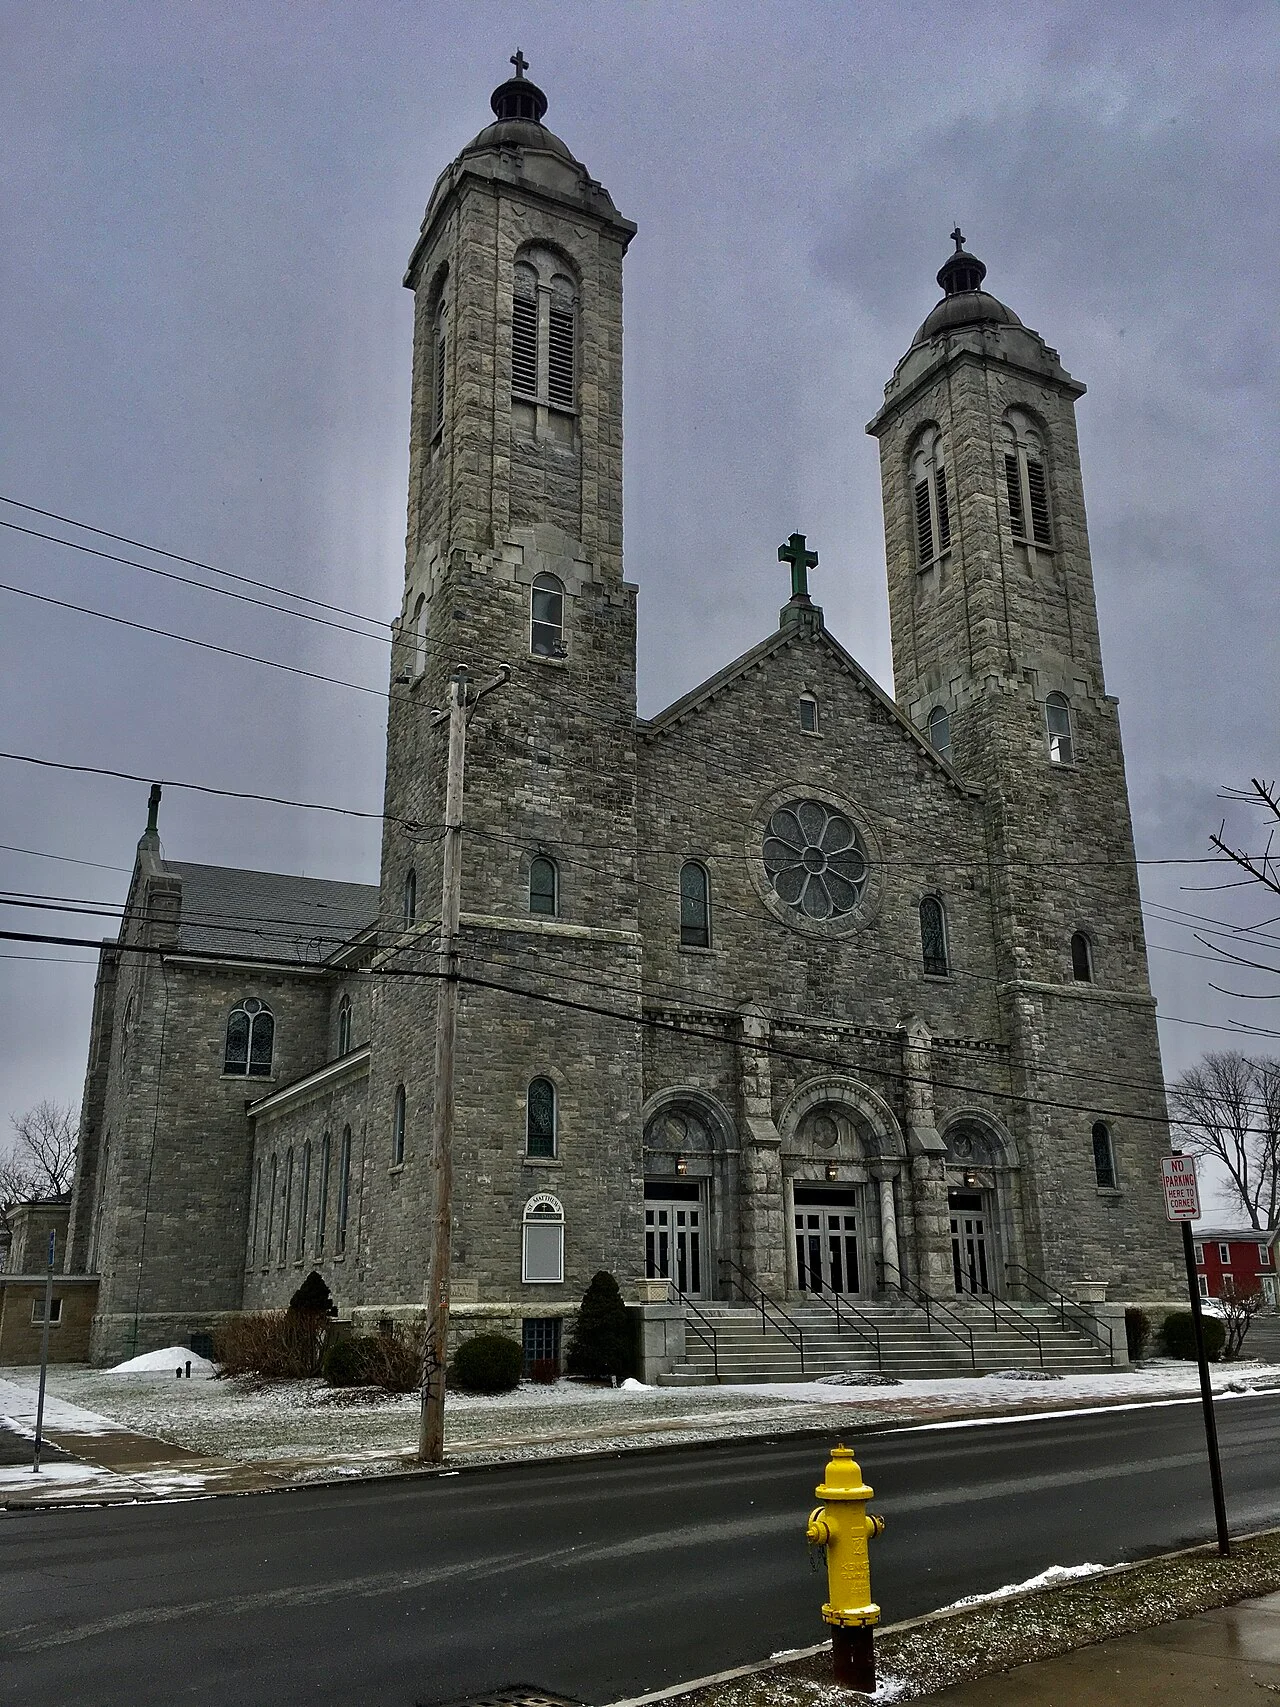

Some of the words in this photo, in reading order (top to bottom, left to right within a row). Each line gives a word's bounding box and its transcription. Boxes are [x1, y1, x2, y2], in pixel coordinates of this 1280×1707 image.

[1171, 1160, 1184, 1172] NO
[1165, 1174, 1194, 1187] PARKING
[1168, 1189, 1185, 1198] HERE
[1186, 1188, 1194, 1197] TO
[1170, 1199, 1195, 1208] CORNER
